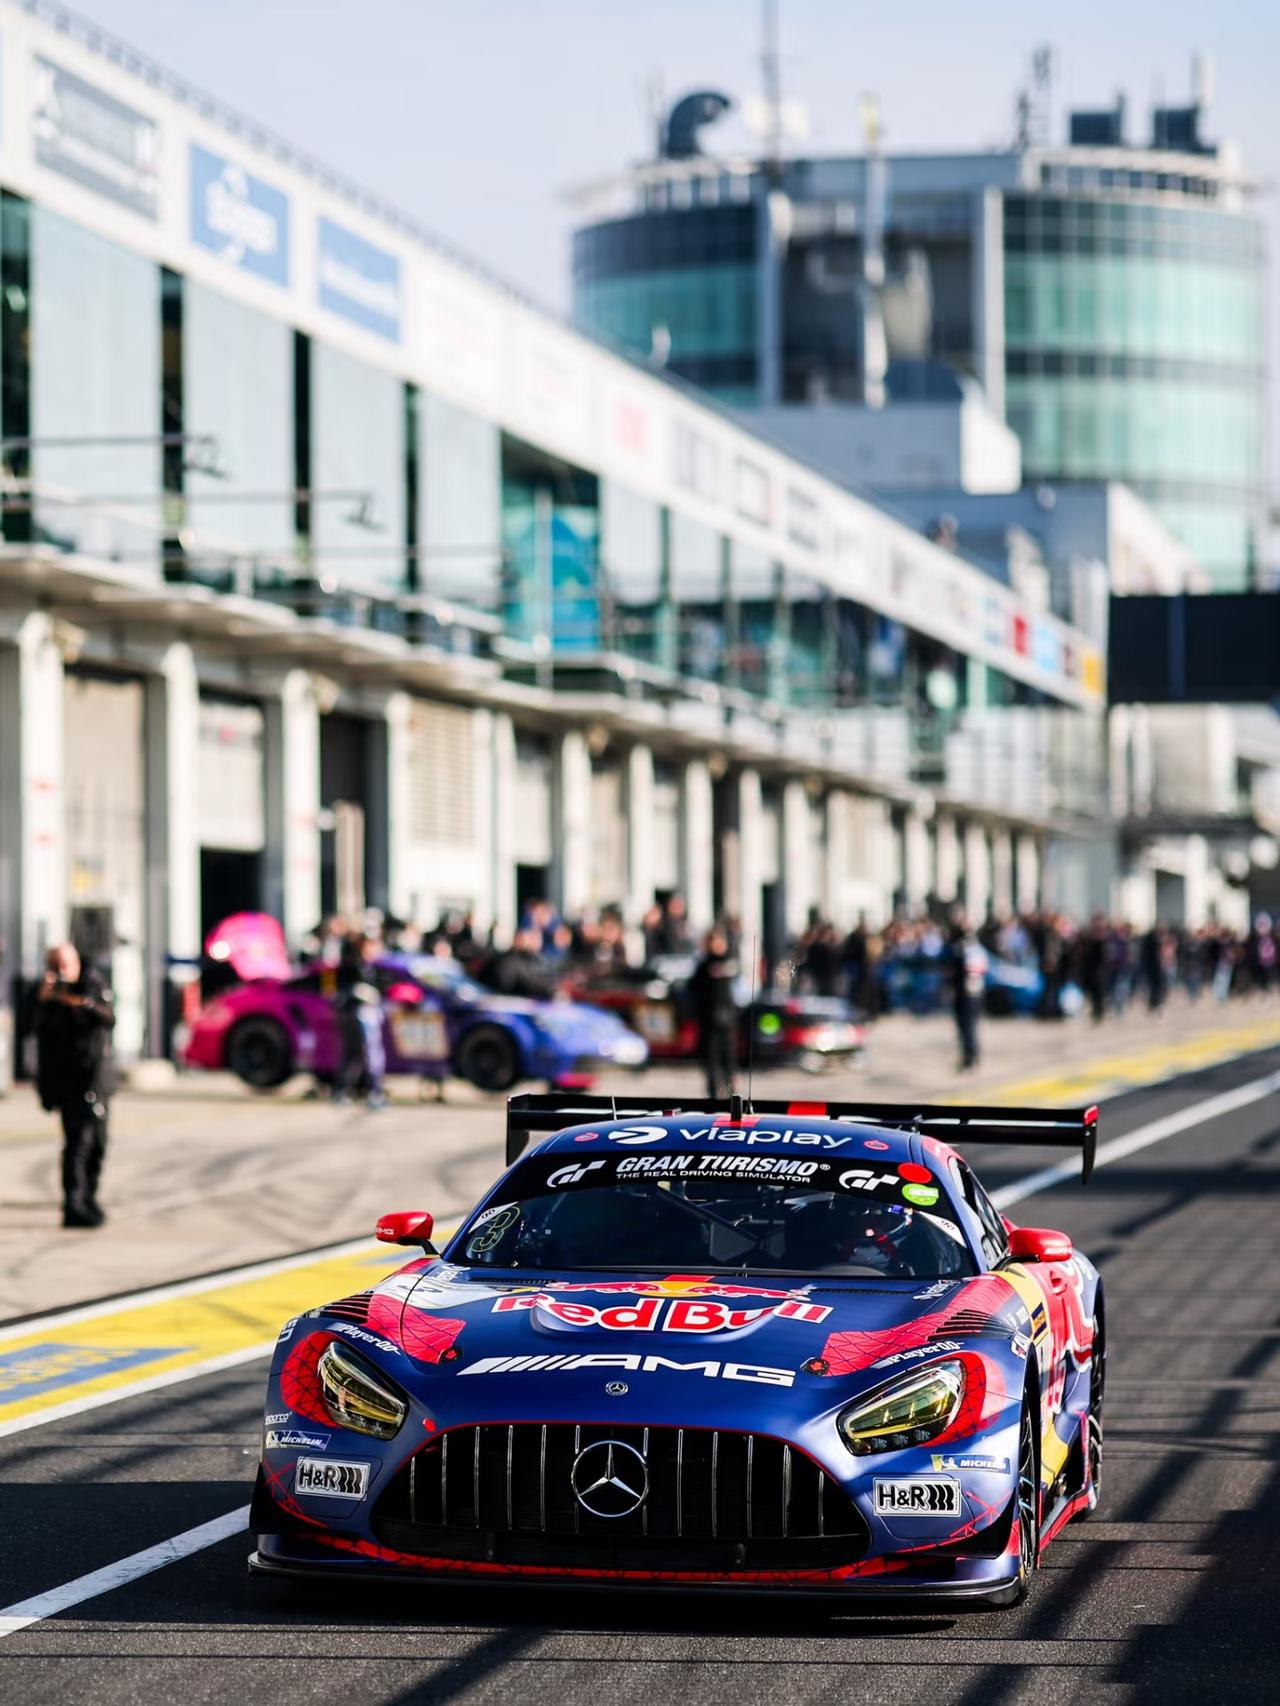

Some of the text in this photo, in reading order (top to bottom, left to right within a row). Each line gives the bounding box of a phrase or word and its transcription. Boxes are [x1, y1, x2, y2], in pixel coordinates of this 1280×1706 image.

[679, 1127, 853, 1149] viaplay
[616, 1154, 697, 1173] GRAN
[680, 1169, 733, 1178] DRIVING
[735, 1171, 811, 1183] SIMULATOR
[491, 1293, 835, 1333] Red Bull
[558, 1353, 796, 1388] AMG
[280, 1435, 323, 1447] MICHELIN
[299, 1462, 339, 1490] H&R
[877, 1483, 928, 1509] H&R
